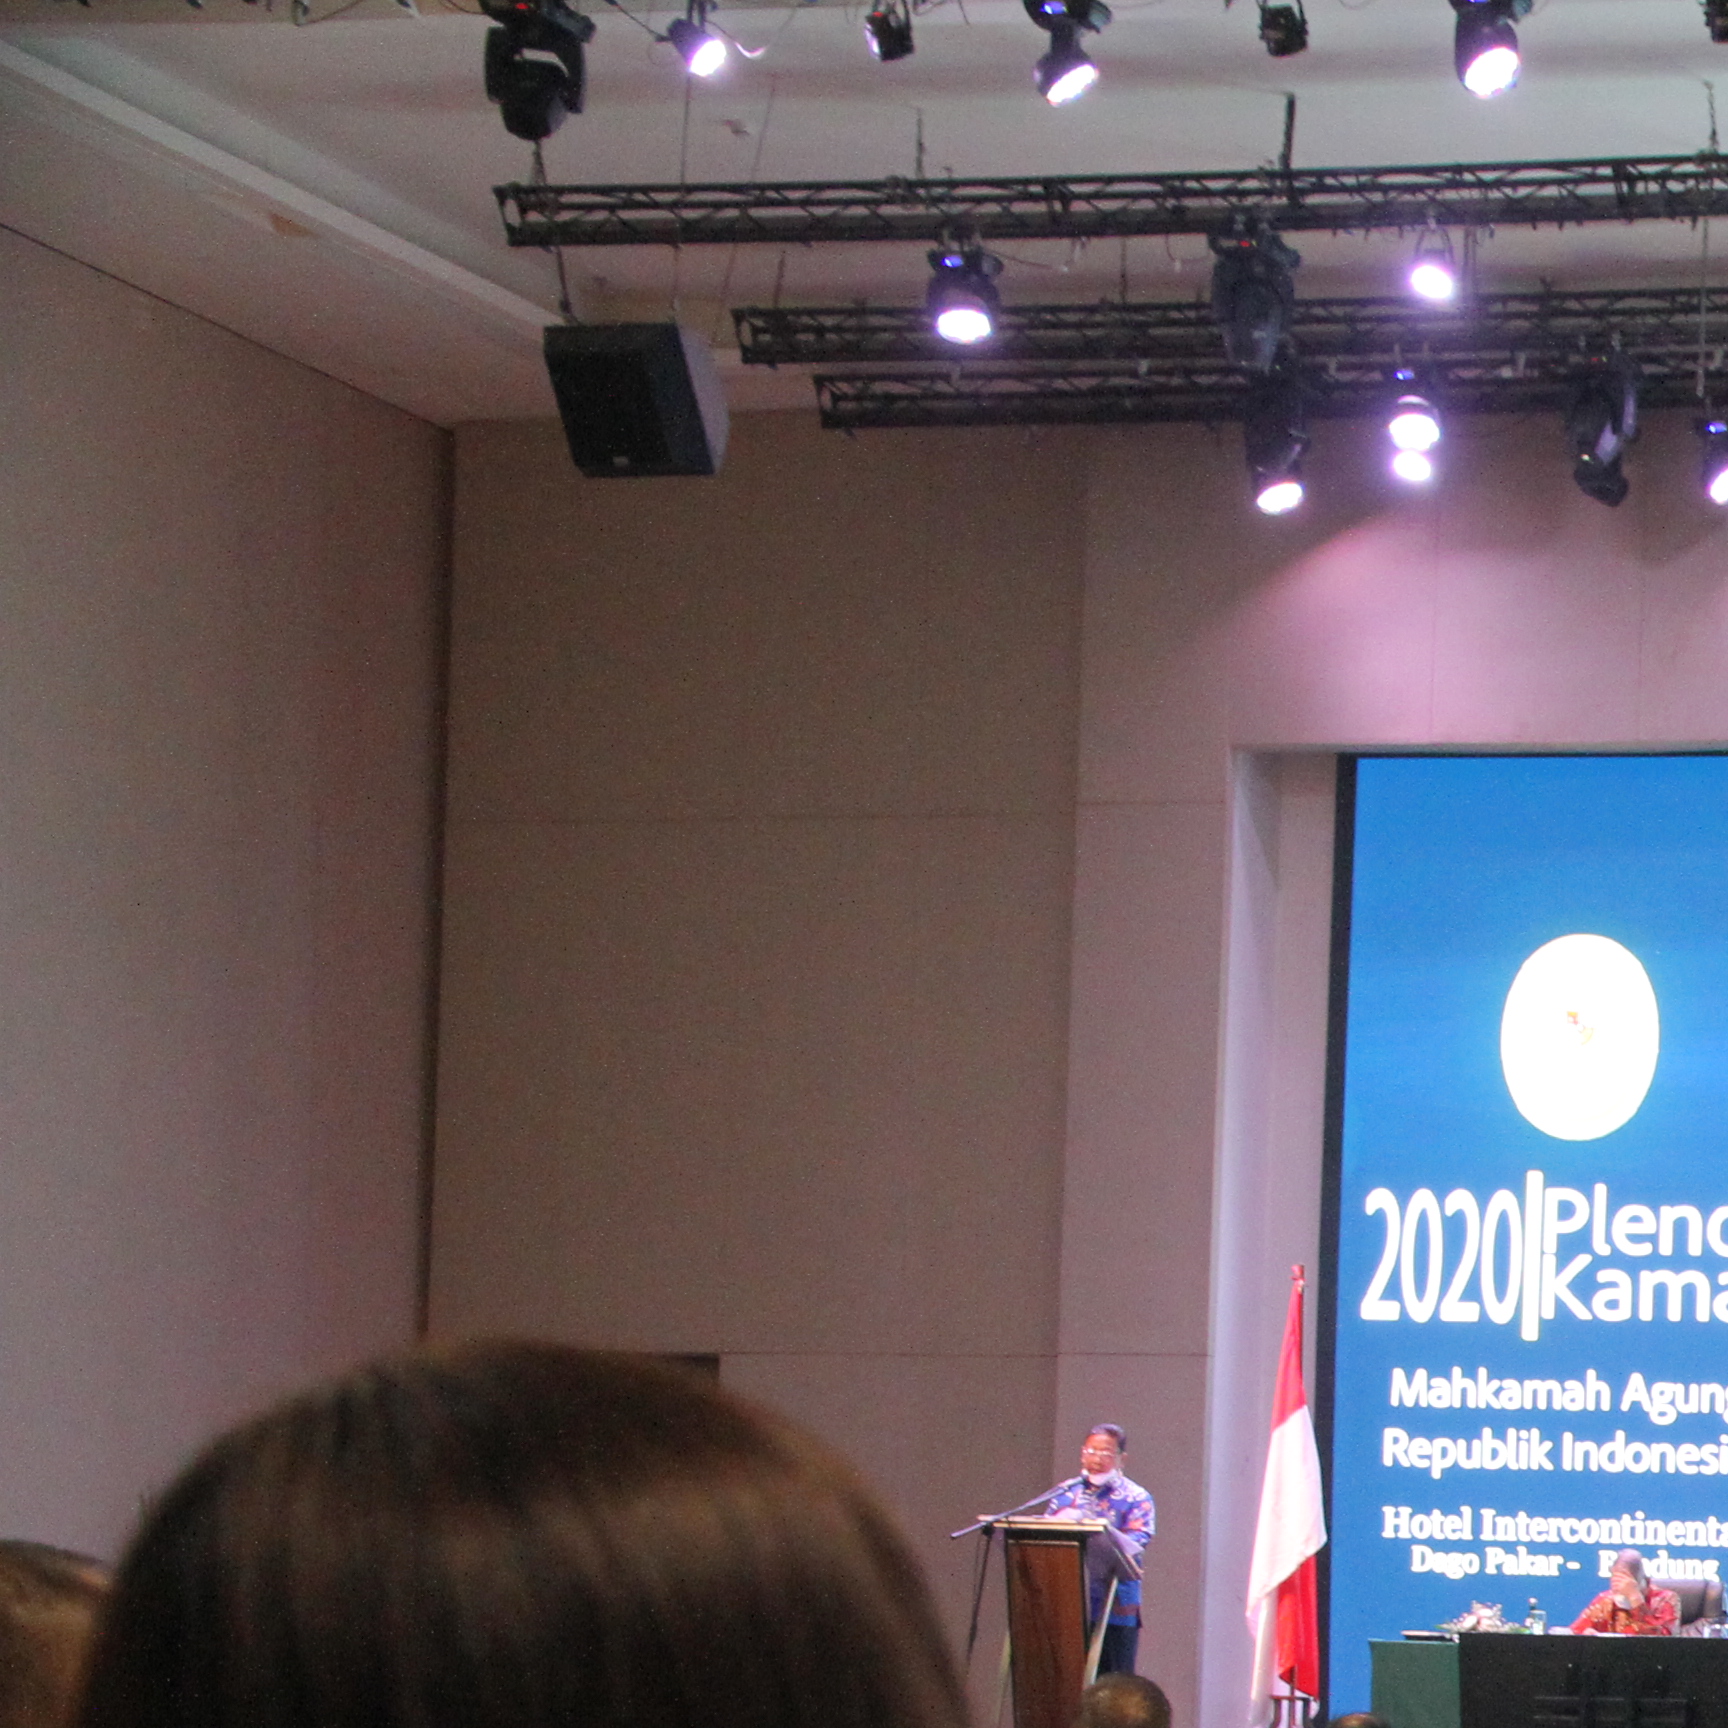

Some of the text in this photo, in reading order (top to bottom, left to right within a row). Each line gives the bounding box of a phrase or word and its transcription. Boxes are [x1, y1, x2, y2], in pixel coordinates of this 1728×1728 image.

[1360, 1187, 1523, 1325] 2020
[1390, 1366, 1611, 1412] Mahkamah
[1382, 1427, 1554, 1480] Republik
[1381, 1506, 1474, 1541] Hotel
[1410, 1544, 1481, 1580] Dago
